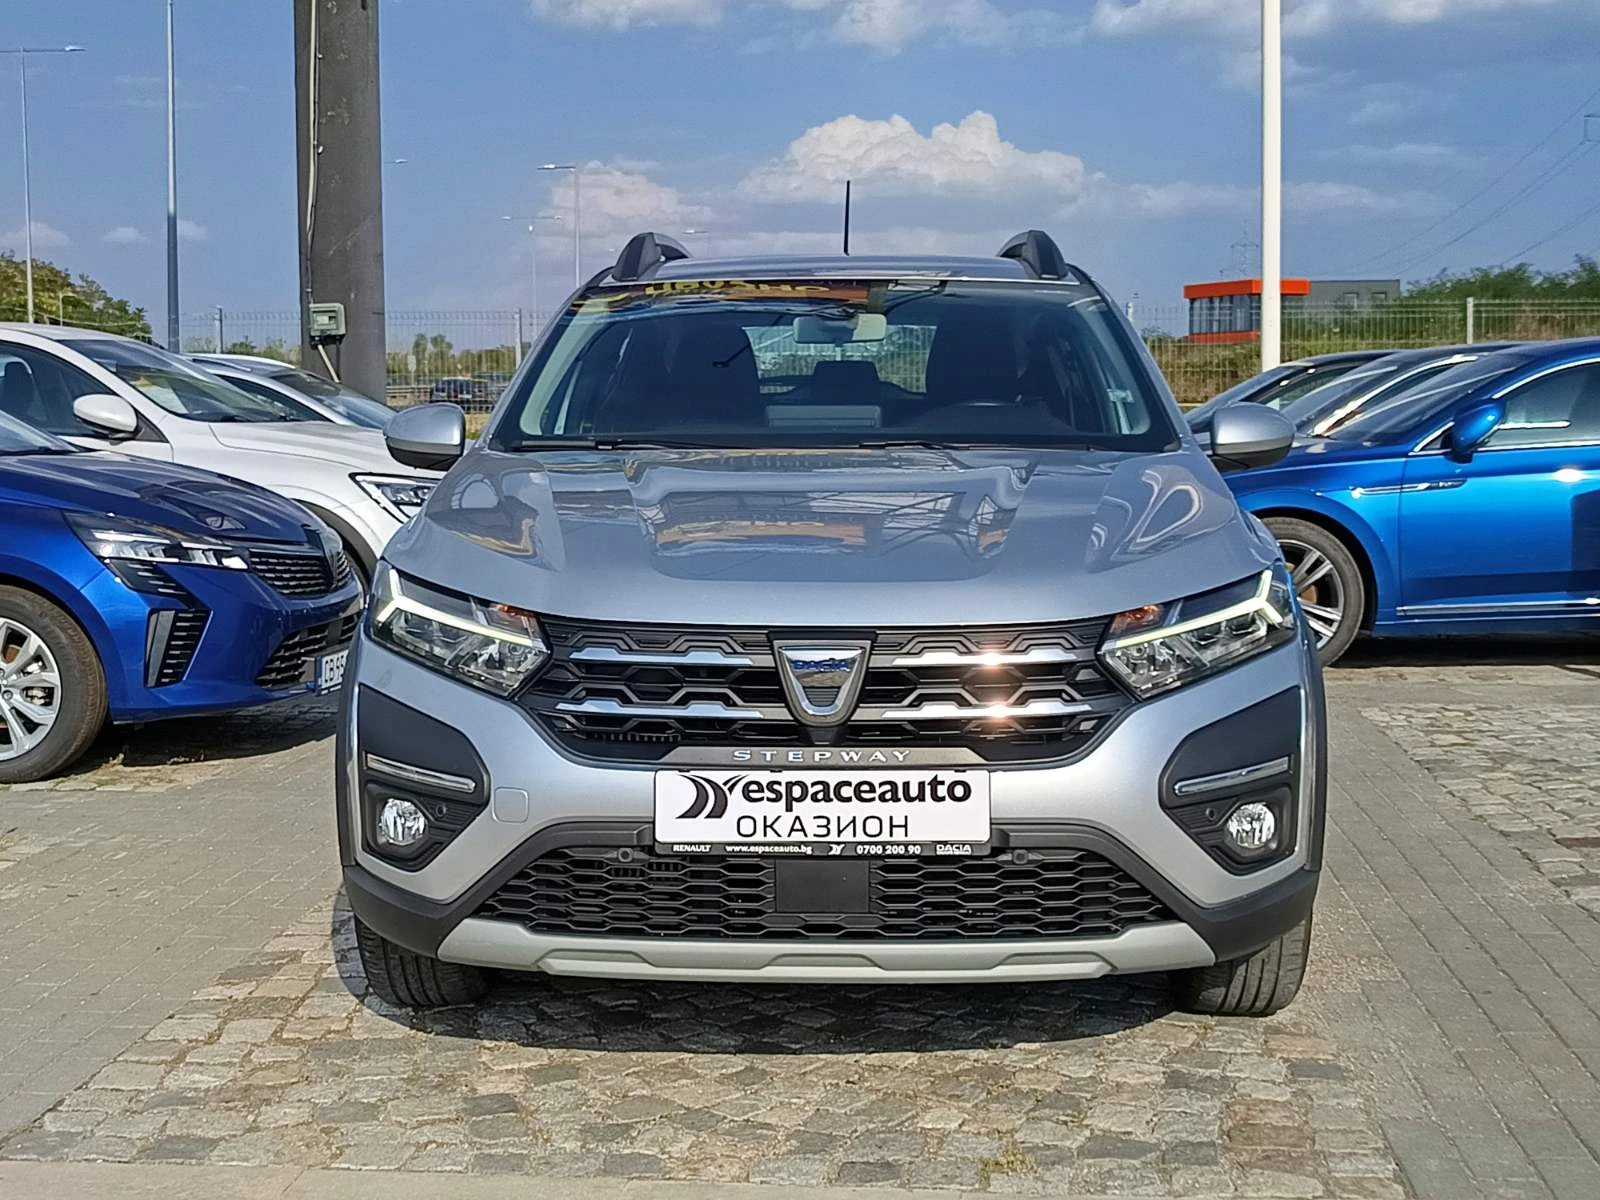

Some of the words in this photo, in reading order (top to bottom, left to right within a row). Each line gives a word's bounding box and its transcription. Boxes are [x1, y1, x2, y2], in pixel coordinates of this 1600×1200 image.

[732, 750, 911, 763] STEPWAY
[741, 774, 972, 813] espaceauto
[736, 815, 909, 838] ОКАЗИОН
[672, 844, 712, 852] RENAULT
[725, 844, 813, 855] www.espaceauto.bg
[856, 844, 883, 855] 0700
[884, 844, 905, 855] 200
[907, 844, 922, 855] 90
[936, 844, 972, 855] DACIA
